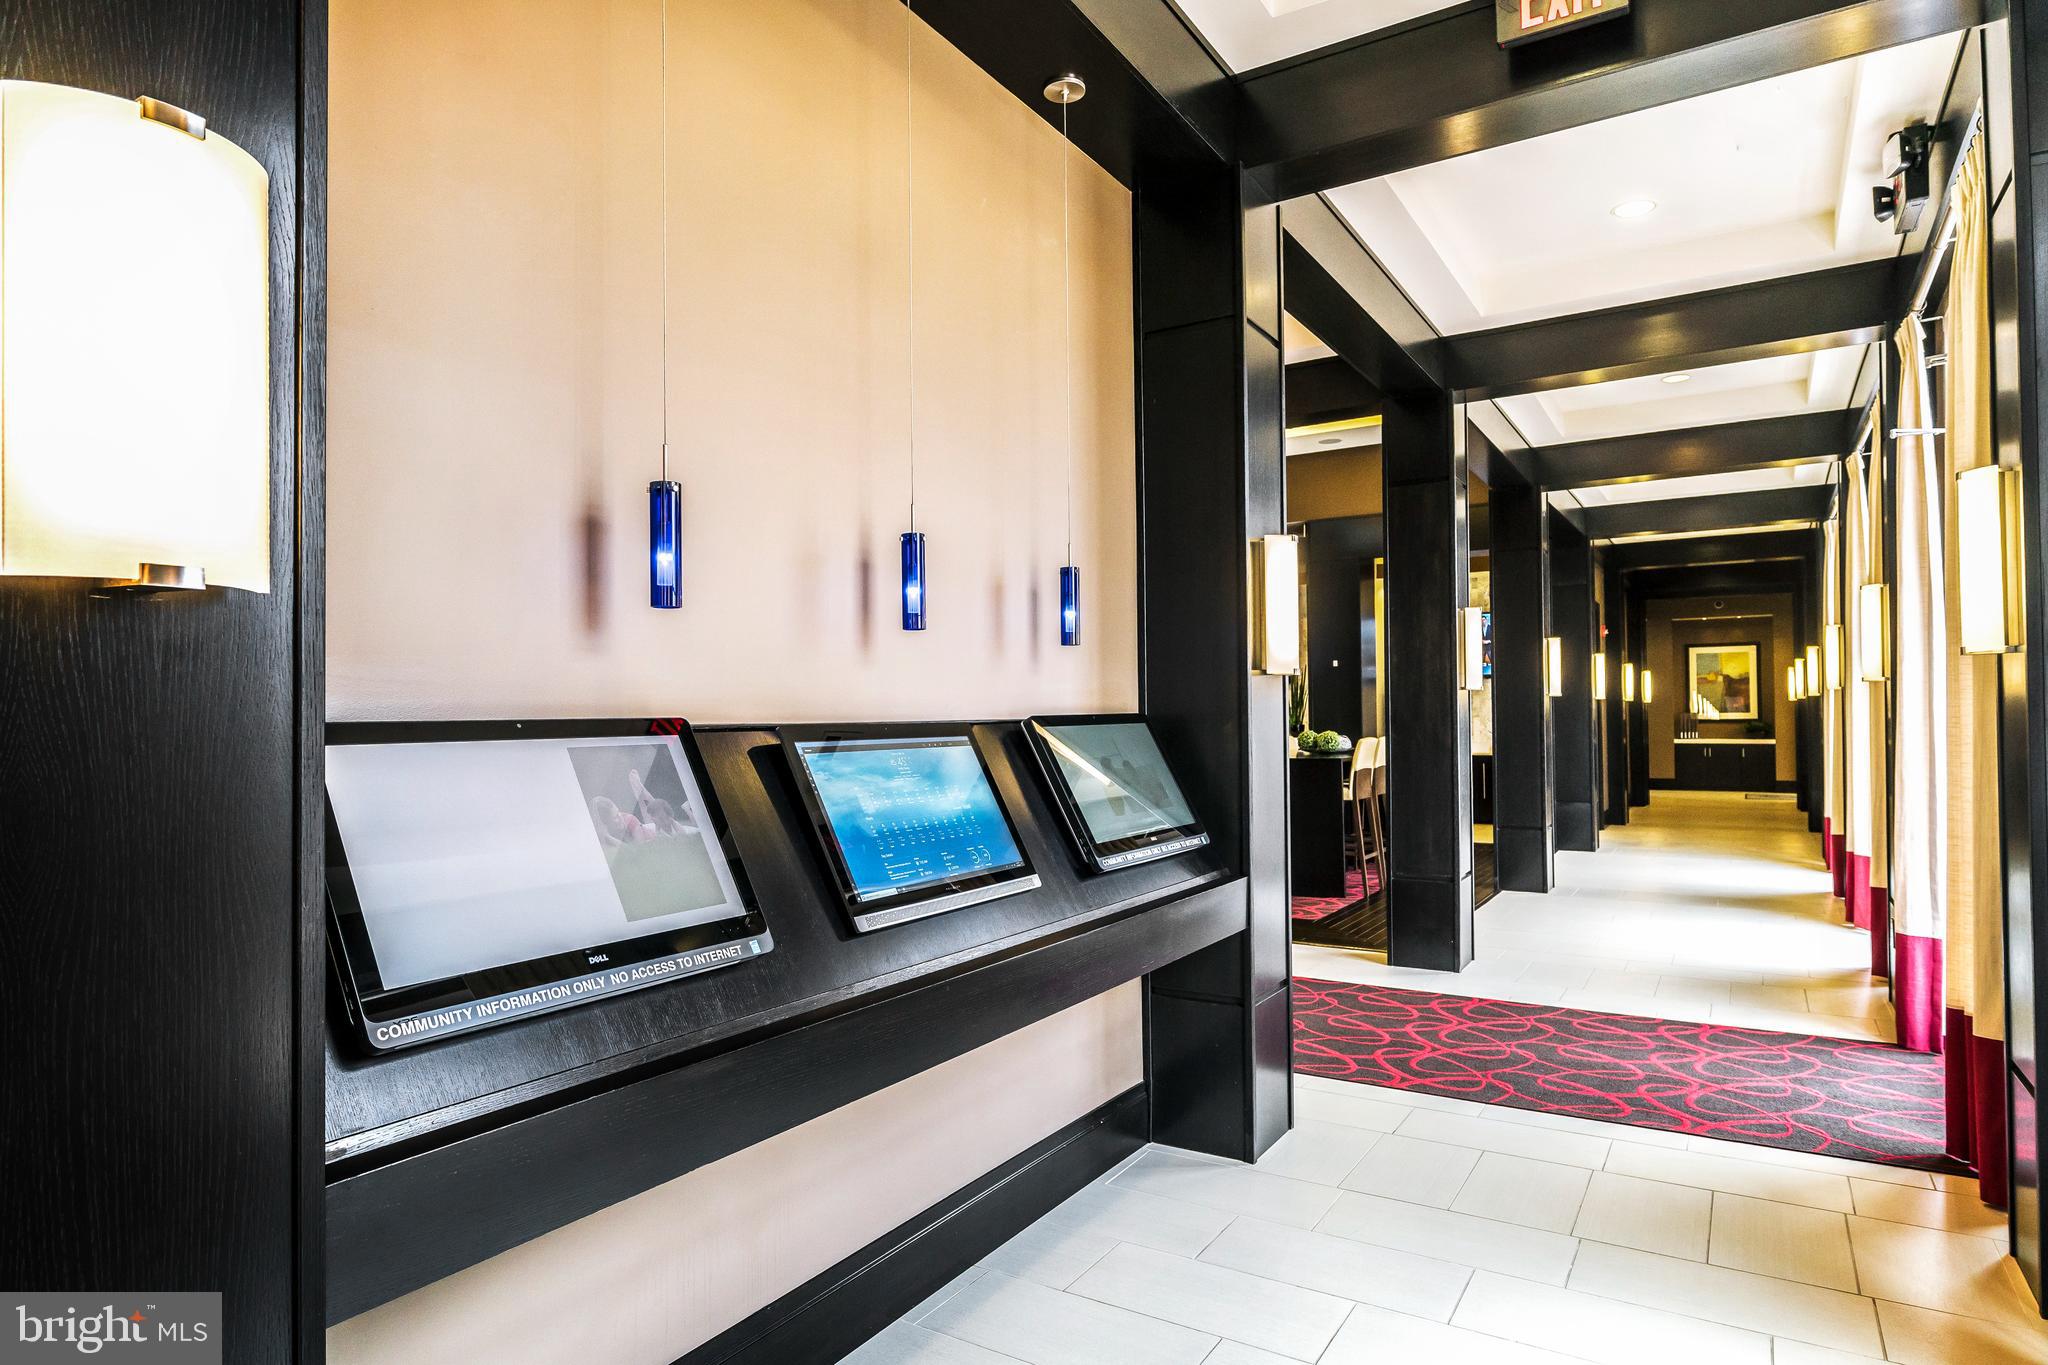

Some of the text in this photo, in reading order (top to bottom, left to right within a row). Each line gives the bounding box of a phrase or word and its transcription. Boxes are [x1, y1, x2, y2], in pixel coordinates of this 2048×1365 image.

[588, 954, 609, 964] DELL
[376, 1006, 473, 1041] COMMUNITY
[476, 985, 572, 1017] INFORMATION
[573, 977, 605, 995] ONLY
[610, 970, 629, 986] NO
[631, 961, 677, 981] ACCESS
[677, 956, 693, 970] TO
[693, 944, 742, 966] INTERNET
